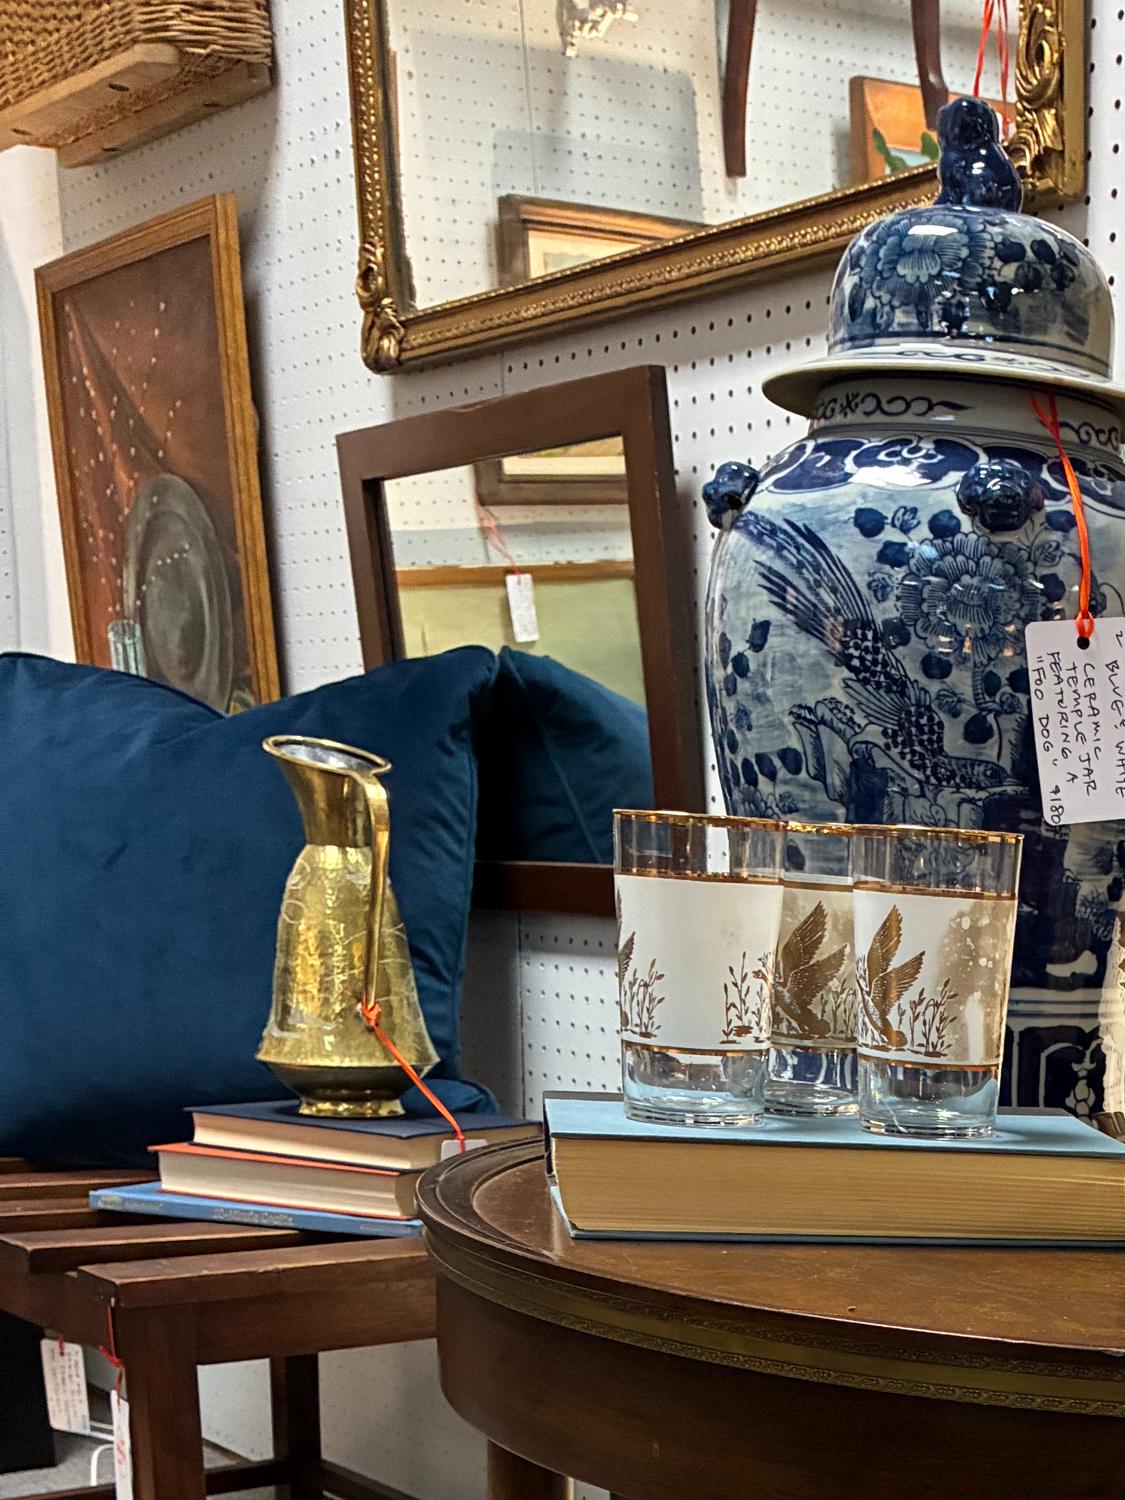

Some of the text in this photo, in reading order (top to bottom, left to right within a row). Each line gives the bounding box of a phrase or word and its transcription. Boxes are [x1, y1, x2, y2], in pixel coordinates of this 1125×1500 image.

[1047, 652, 1073, 760] FEATURING
[1066, 661, 1097, 796] TEMPLE JAR
[1083, 662, 1102, 760] CERAMIC
[1105, 659, 1125, 717] BLUE
